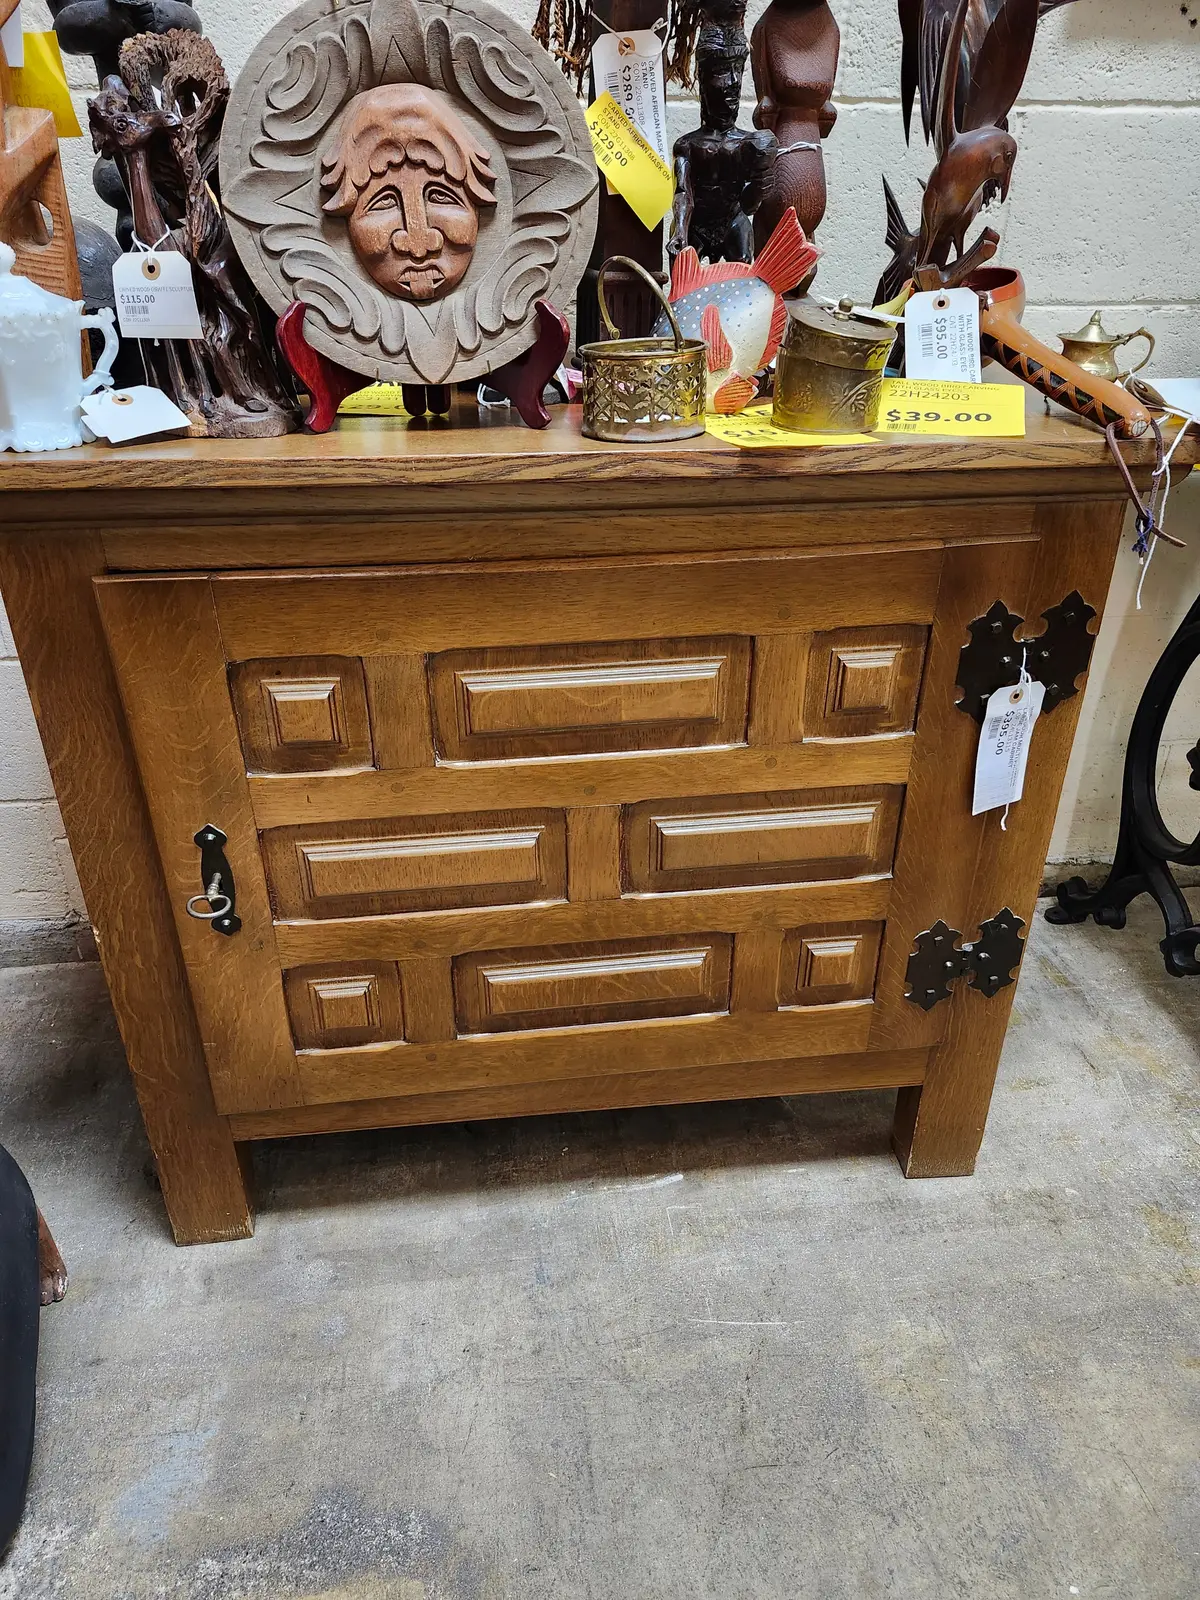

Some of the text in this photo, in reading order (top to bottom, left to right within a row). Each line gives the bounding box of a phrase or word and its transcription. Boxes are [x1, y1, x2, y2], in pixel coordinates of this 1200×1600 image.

[633, 63, 641, 82] CON
[641, 61, 649, 89] STAND
[648, 60, 657, 93] CARVED
[603, 108, 621, 130] STAND
[652, 95, 661, 129] AFRICAN
[590, 121, 628, 167] $129.00
[597, 114, 636, 161] CON 22G11308
[608, 101, 672, 181] CARVED AFRICAN MASK ON
[655, 131, 664, 153] MASK
[120, 294, 155, 304] $115.00
[934, 317, 948, 360] $95.00
[960, 356, 968, 373] EYES
[889, 389, 970, 401] 22H24203
[886, 409, 992, 422] $39.00
[995, 710, 1015, 755] $395.00
